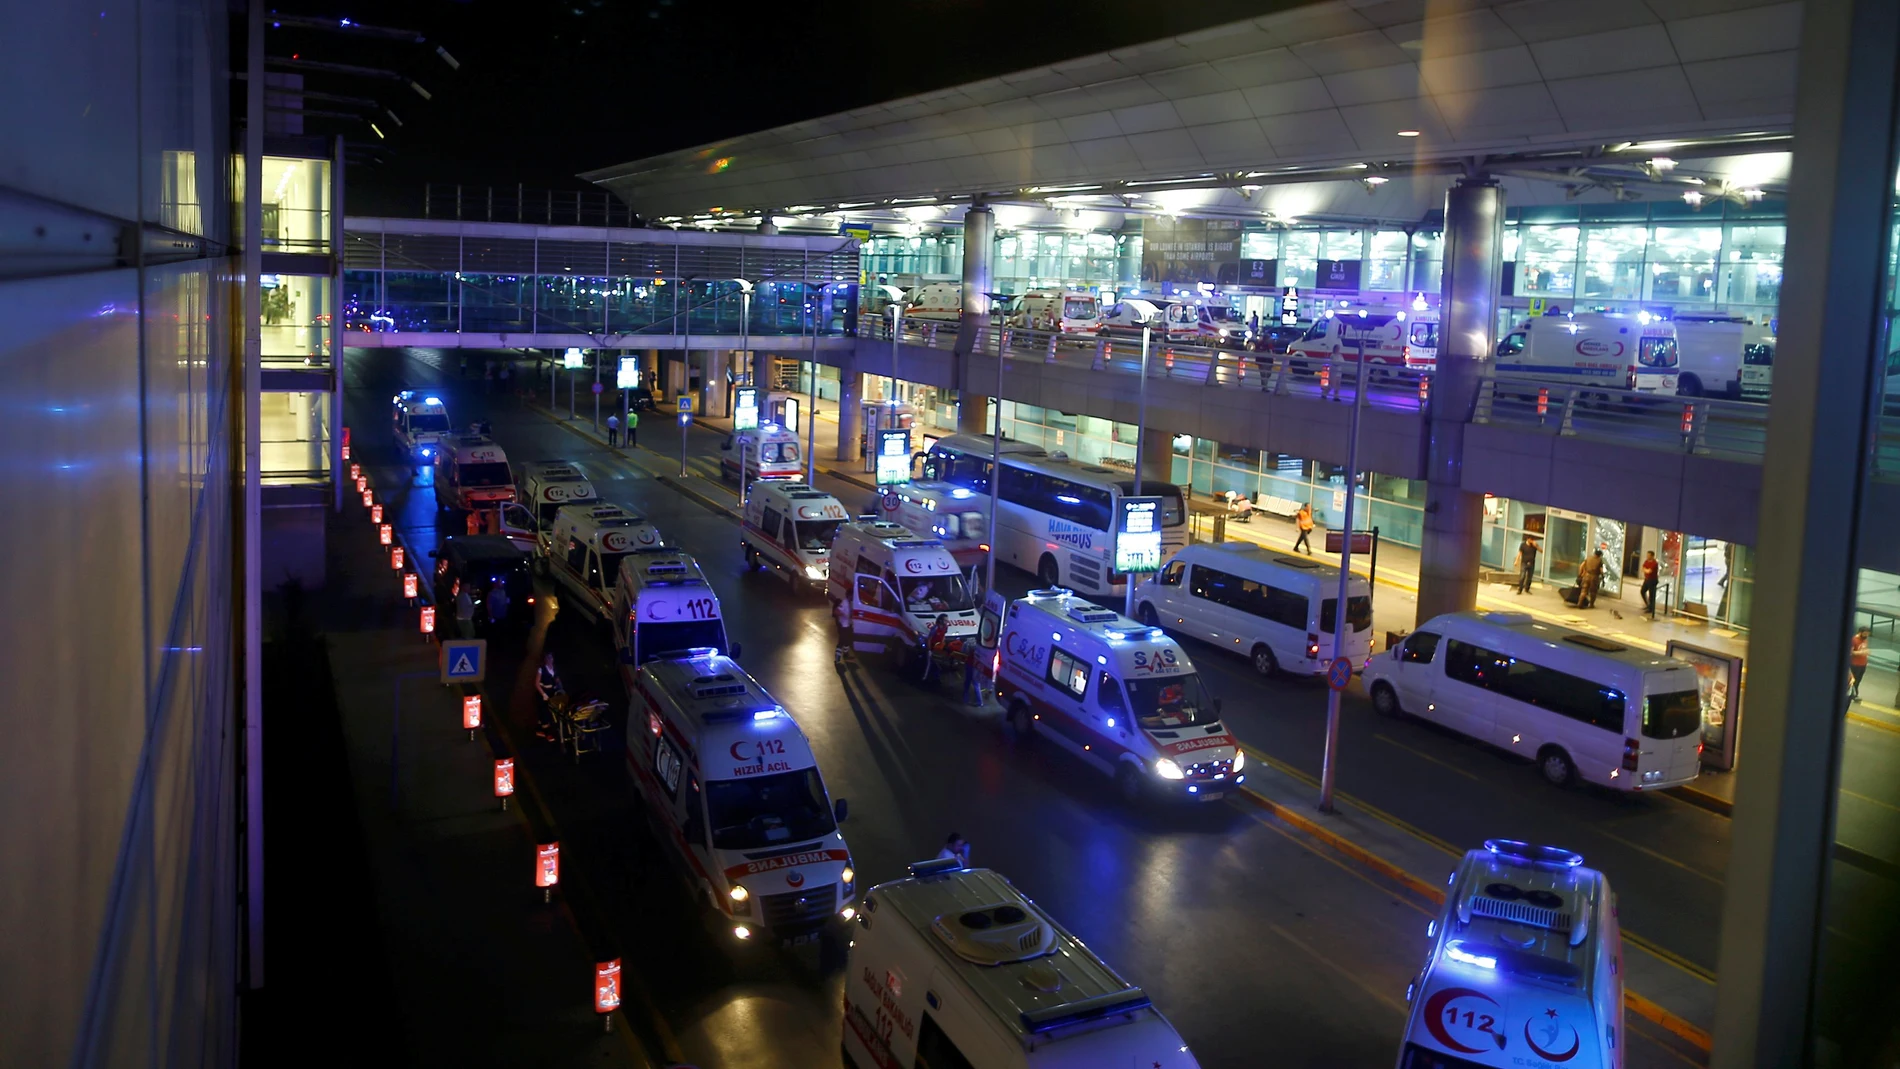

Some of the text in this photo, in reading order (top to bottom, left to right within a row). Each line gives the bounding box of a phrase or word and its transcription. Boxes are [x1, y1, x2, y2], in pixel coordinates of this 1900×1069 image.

[1150, 243, 1158, 251] OUR
[1184, 243, 1206, 251] ISTANBUL
[1215, 243, 1233, 251] BIGGER
[1163, 252, 1175, 260] THAN
[1176, 252, 1189, 260] SOME
[549, 489, 564, 497] 112
[885, 497, 898, 506] 30
[824, 505, 843, 519] 112
[610, 536, 628, 547] 112
[909, 562, 922, 570] 112
[687, 598, 717, 619] 112
[757, 740, 785, 755] 112
[734, 760, 792, 776] HIZIR ACİL
[1446, 1007, 1495, 1034] 112
[876, 1007, 893, 1047] 112
